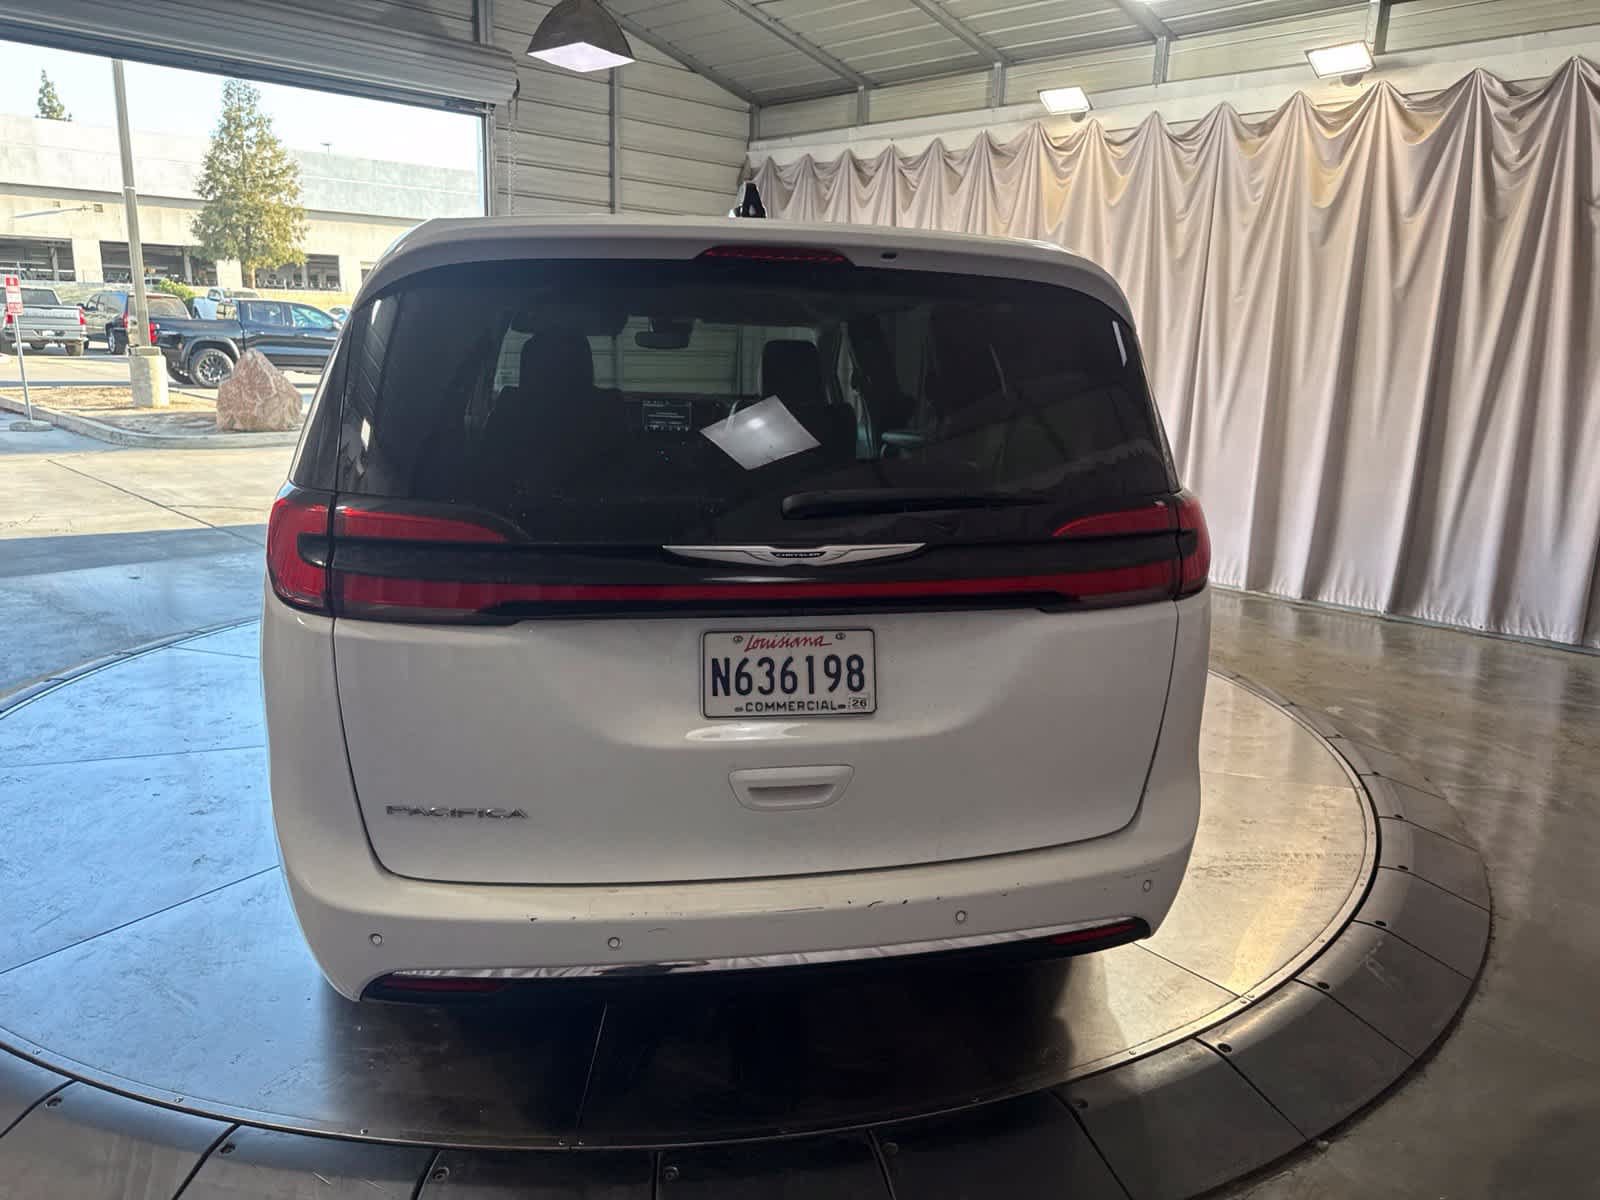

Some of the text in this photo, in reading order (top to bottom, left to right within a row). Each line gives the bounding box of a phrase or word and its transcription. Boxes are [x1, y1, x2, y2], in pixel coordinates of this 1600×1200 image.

[744, 634, 833, 653] Louisiana
[711, 654, 865, 697] N636198
[745, 700, 838, 713] COMMERCIAL
[385, 805, 529, 819] PACIFICA
